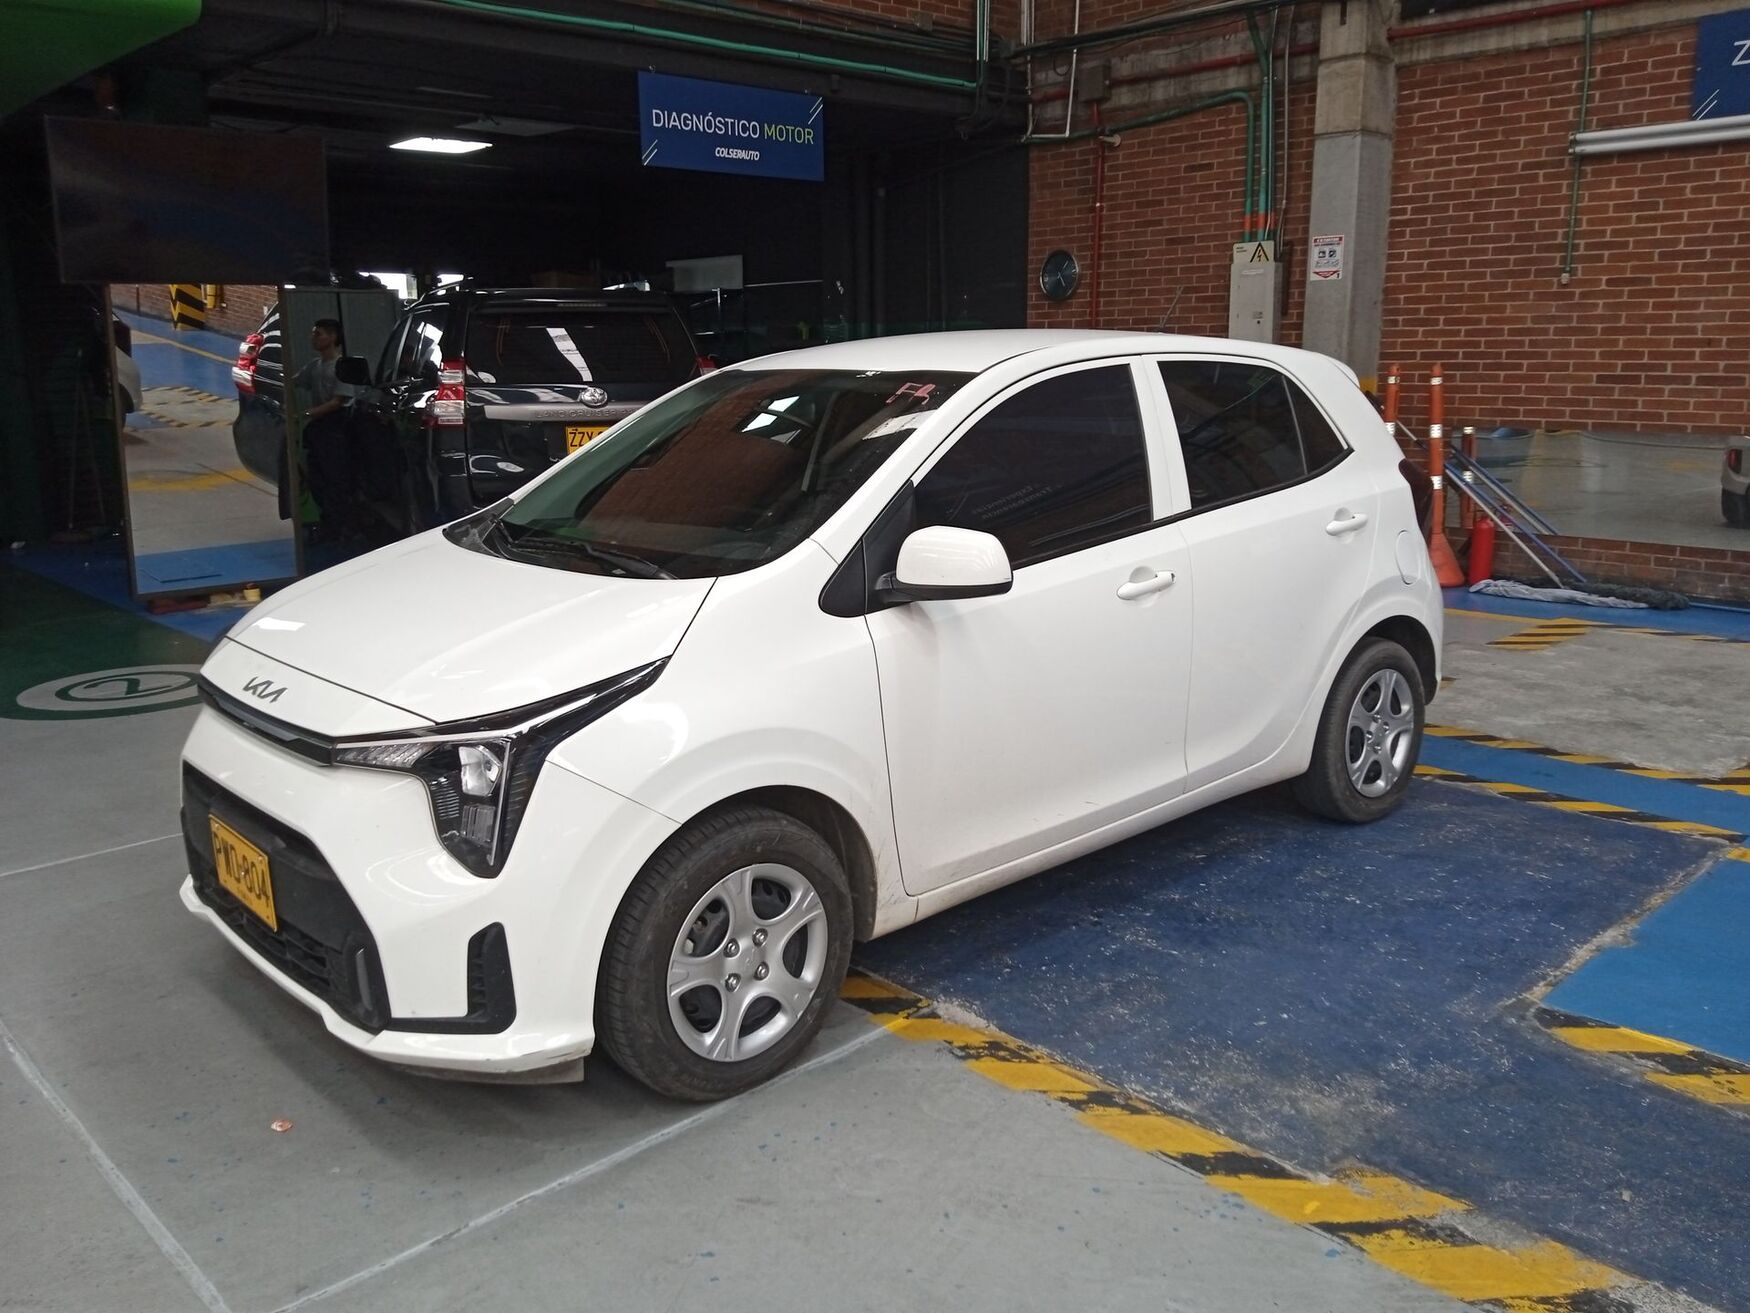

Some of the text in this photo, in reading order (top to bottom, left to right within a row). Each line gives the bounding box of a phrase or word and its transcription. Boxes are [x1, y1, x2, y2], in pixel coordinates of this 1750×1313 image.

[652, 109, 815, 144] DIAGNÓSTICO MOTOR
[714, 147, 761, 161] COLSERAUTO
[569, 408, 618, 417] CRUISER
